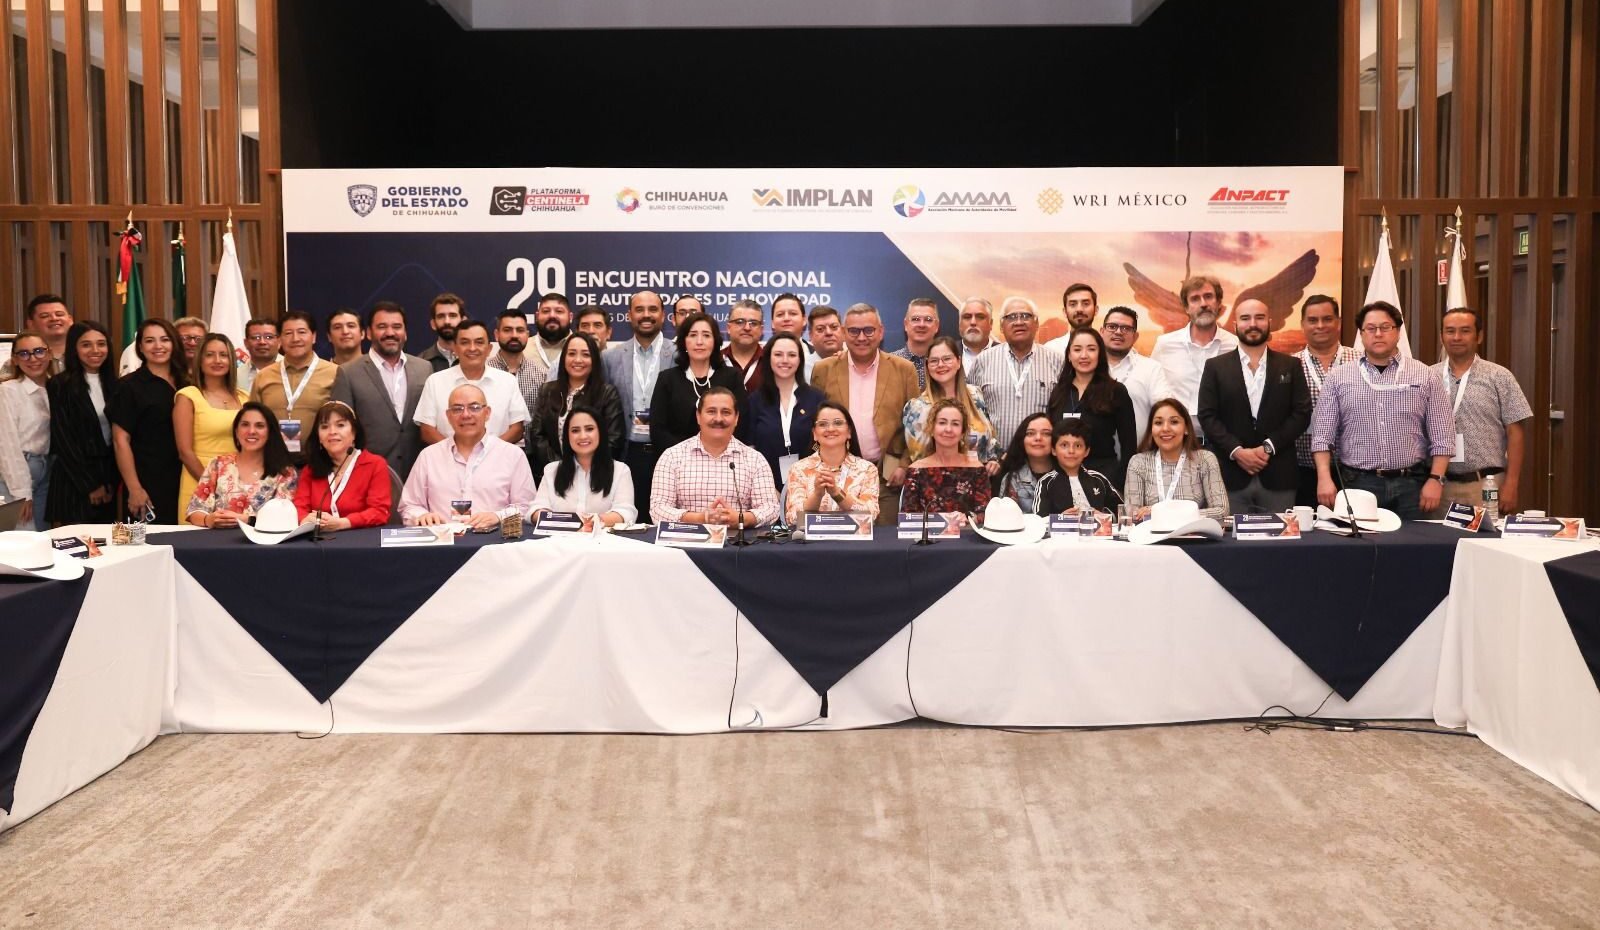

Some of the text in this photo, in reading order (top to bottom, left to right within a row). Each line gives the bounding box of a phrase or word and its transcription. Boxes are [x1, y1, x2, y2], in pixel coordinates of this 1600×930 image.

[387, 186, 463, 197] GOBIERNO
[644, 191, 729, 202] CHIHUAHUA
[786, 189, 873, 207] IMPLAN
[1208, 187, 1291, 201] ANPACT
[382, 198, 469, 208] DEL ESTADO
[526, 196, 586, 205] CENTINELA
[1073, 191, 1187, 207] WRI MÉXICO
[575, 270, 831, 288] ENCUENTRO NACIONAL
[575, 293, 597, 306] DE
[716, 293, 737, 306] DE
